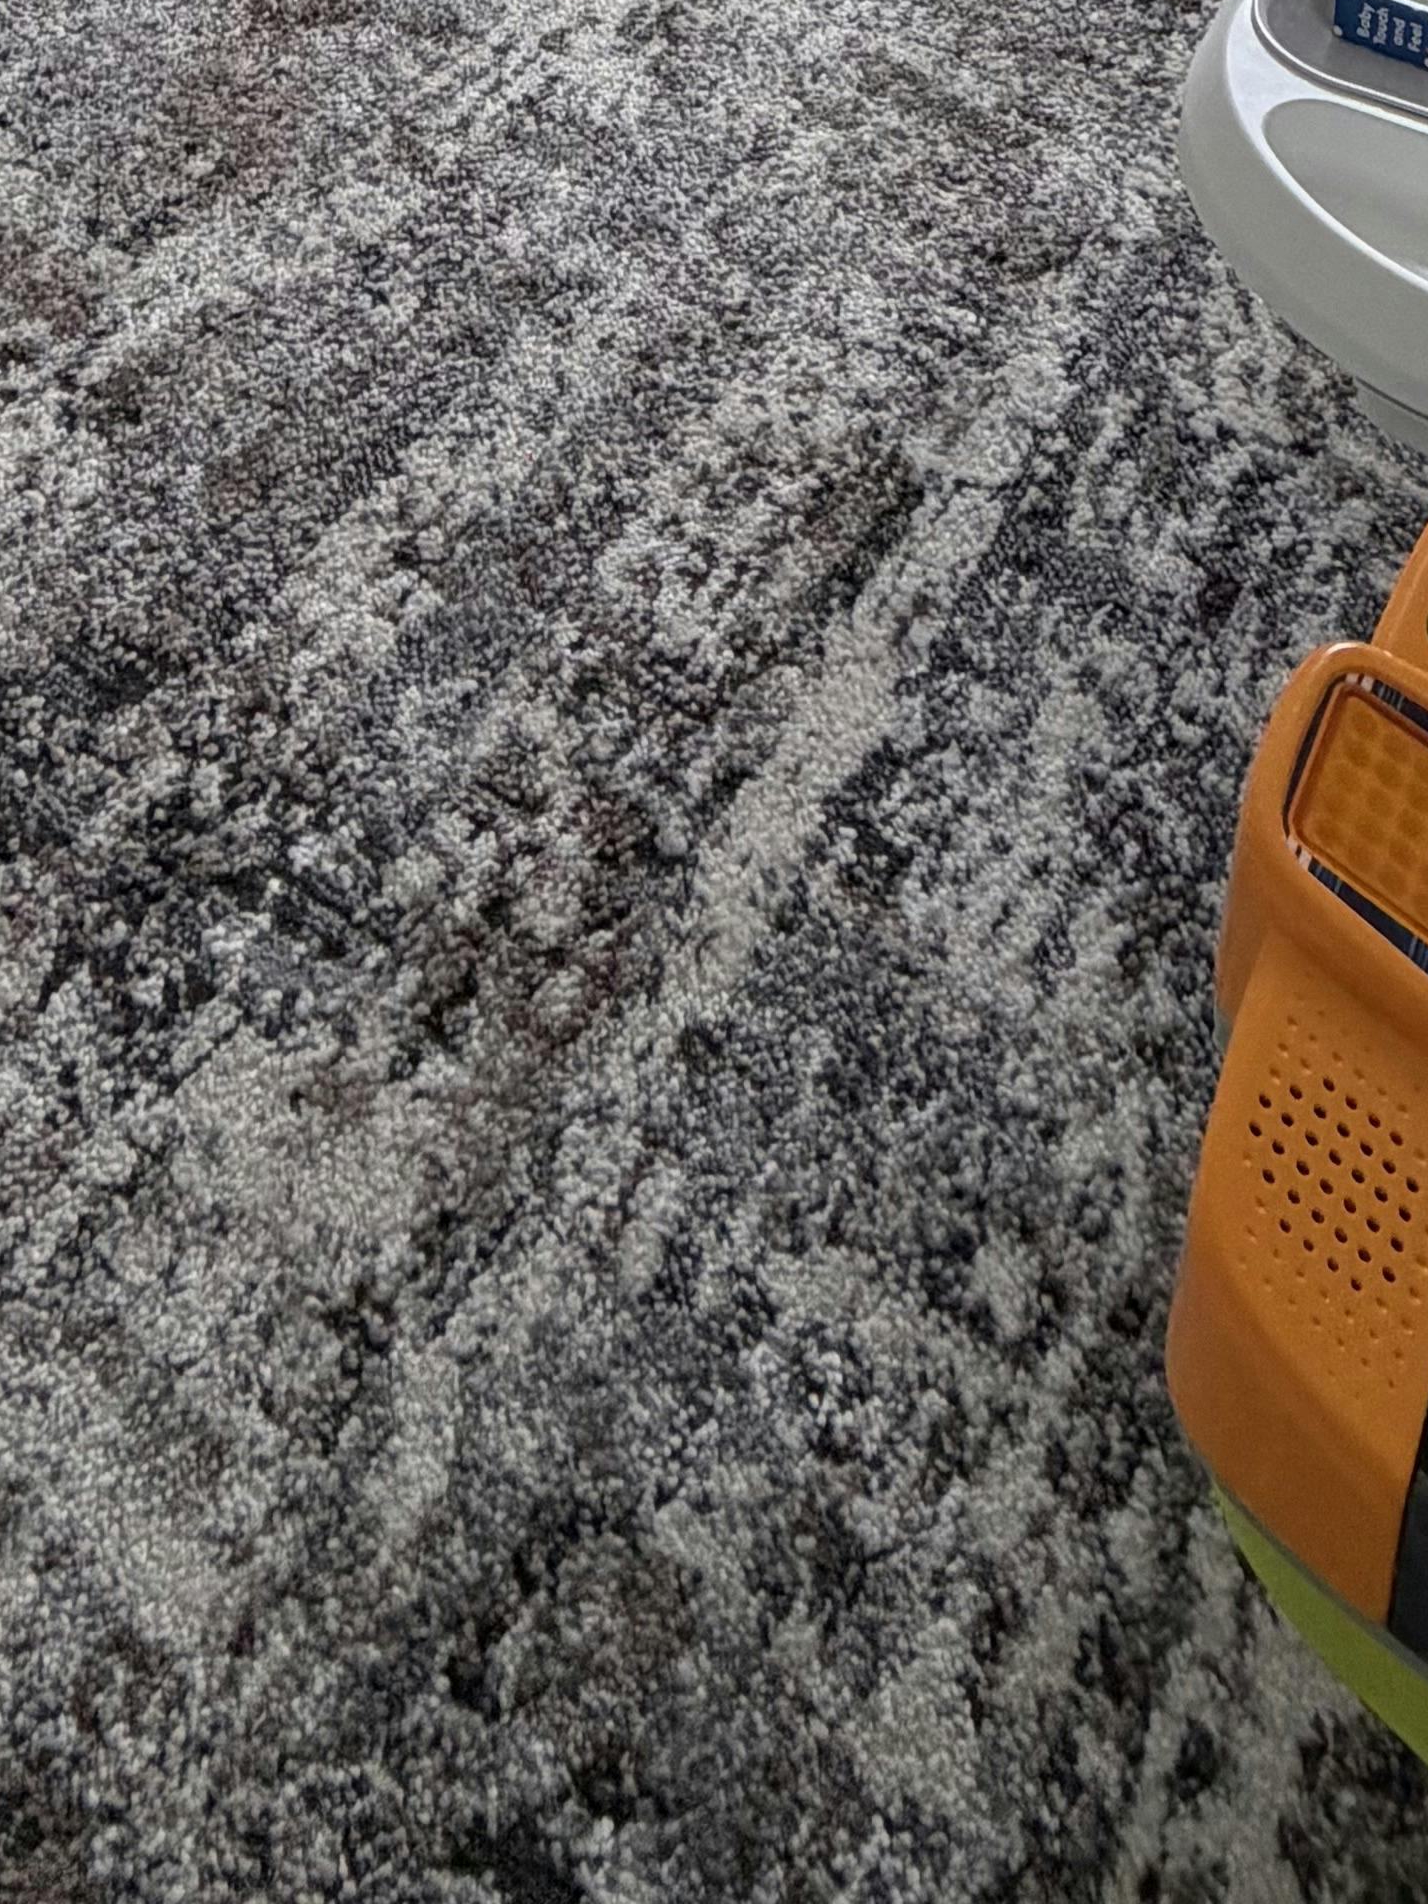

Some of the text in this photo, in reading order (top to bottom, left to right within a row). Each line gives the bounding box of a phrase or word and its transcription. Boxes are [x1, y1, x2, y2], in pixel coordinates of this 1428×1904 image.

[1356, 1, 1376, 39] Baby
[1372, 7, 1390, 46] Touch
[1392, 17, 1406, 47] and
